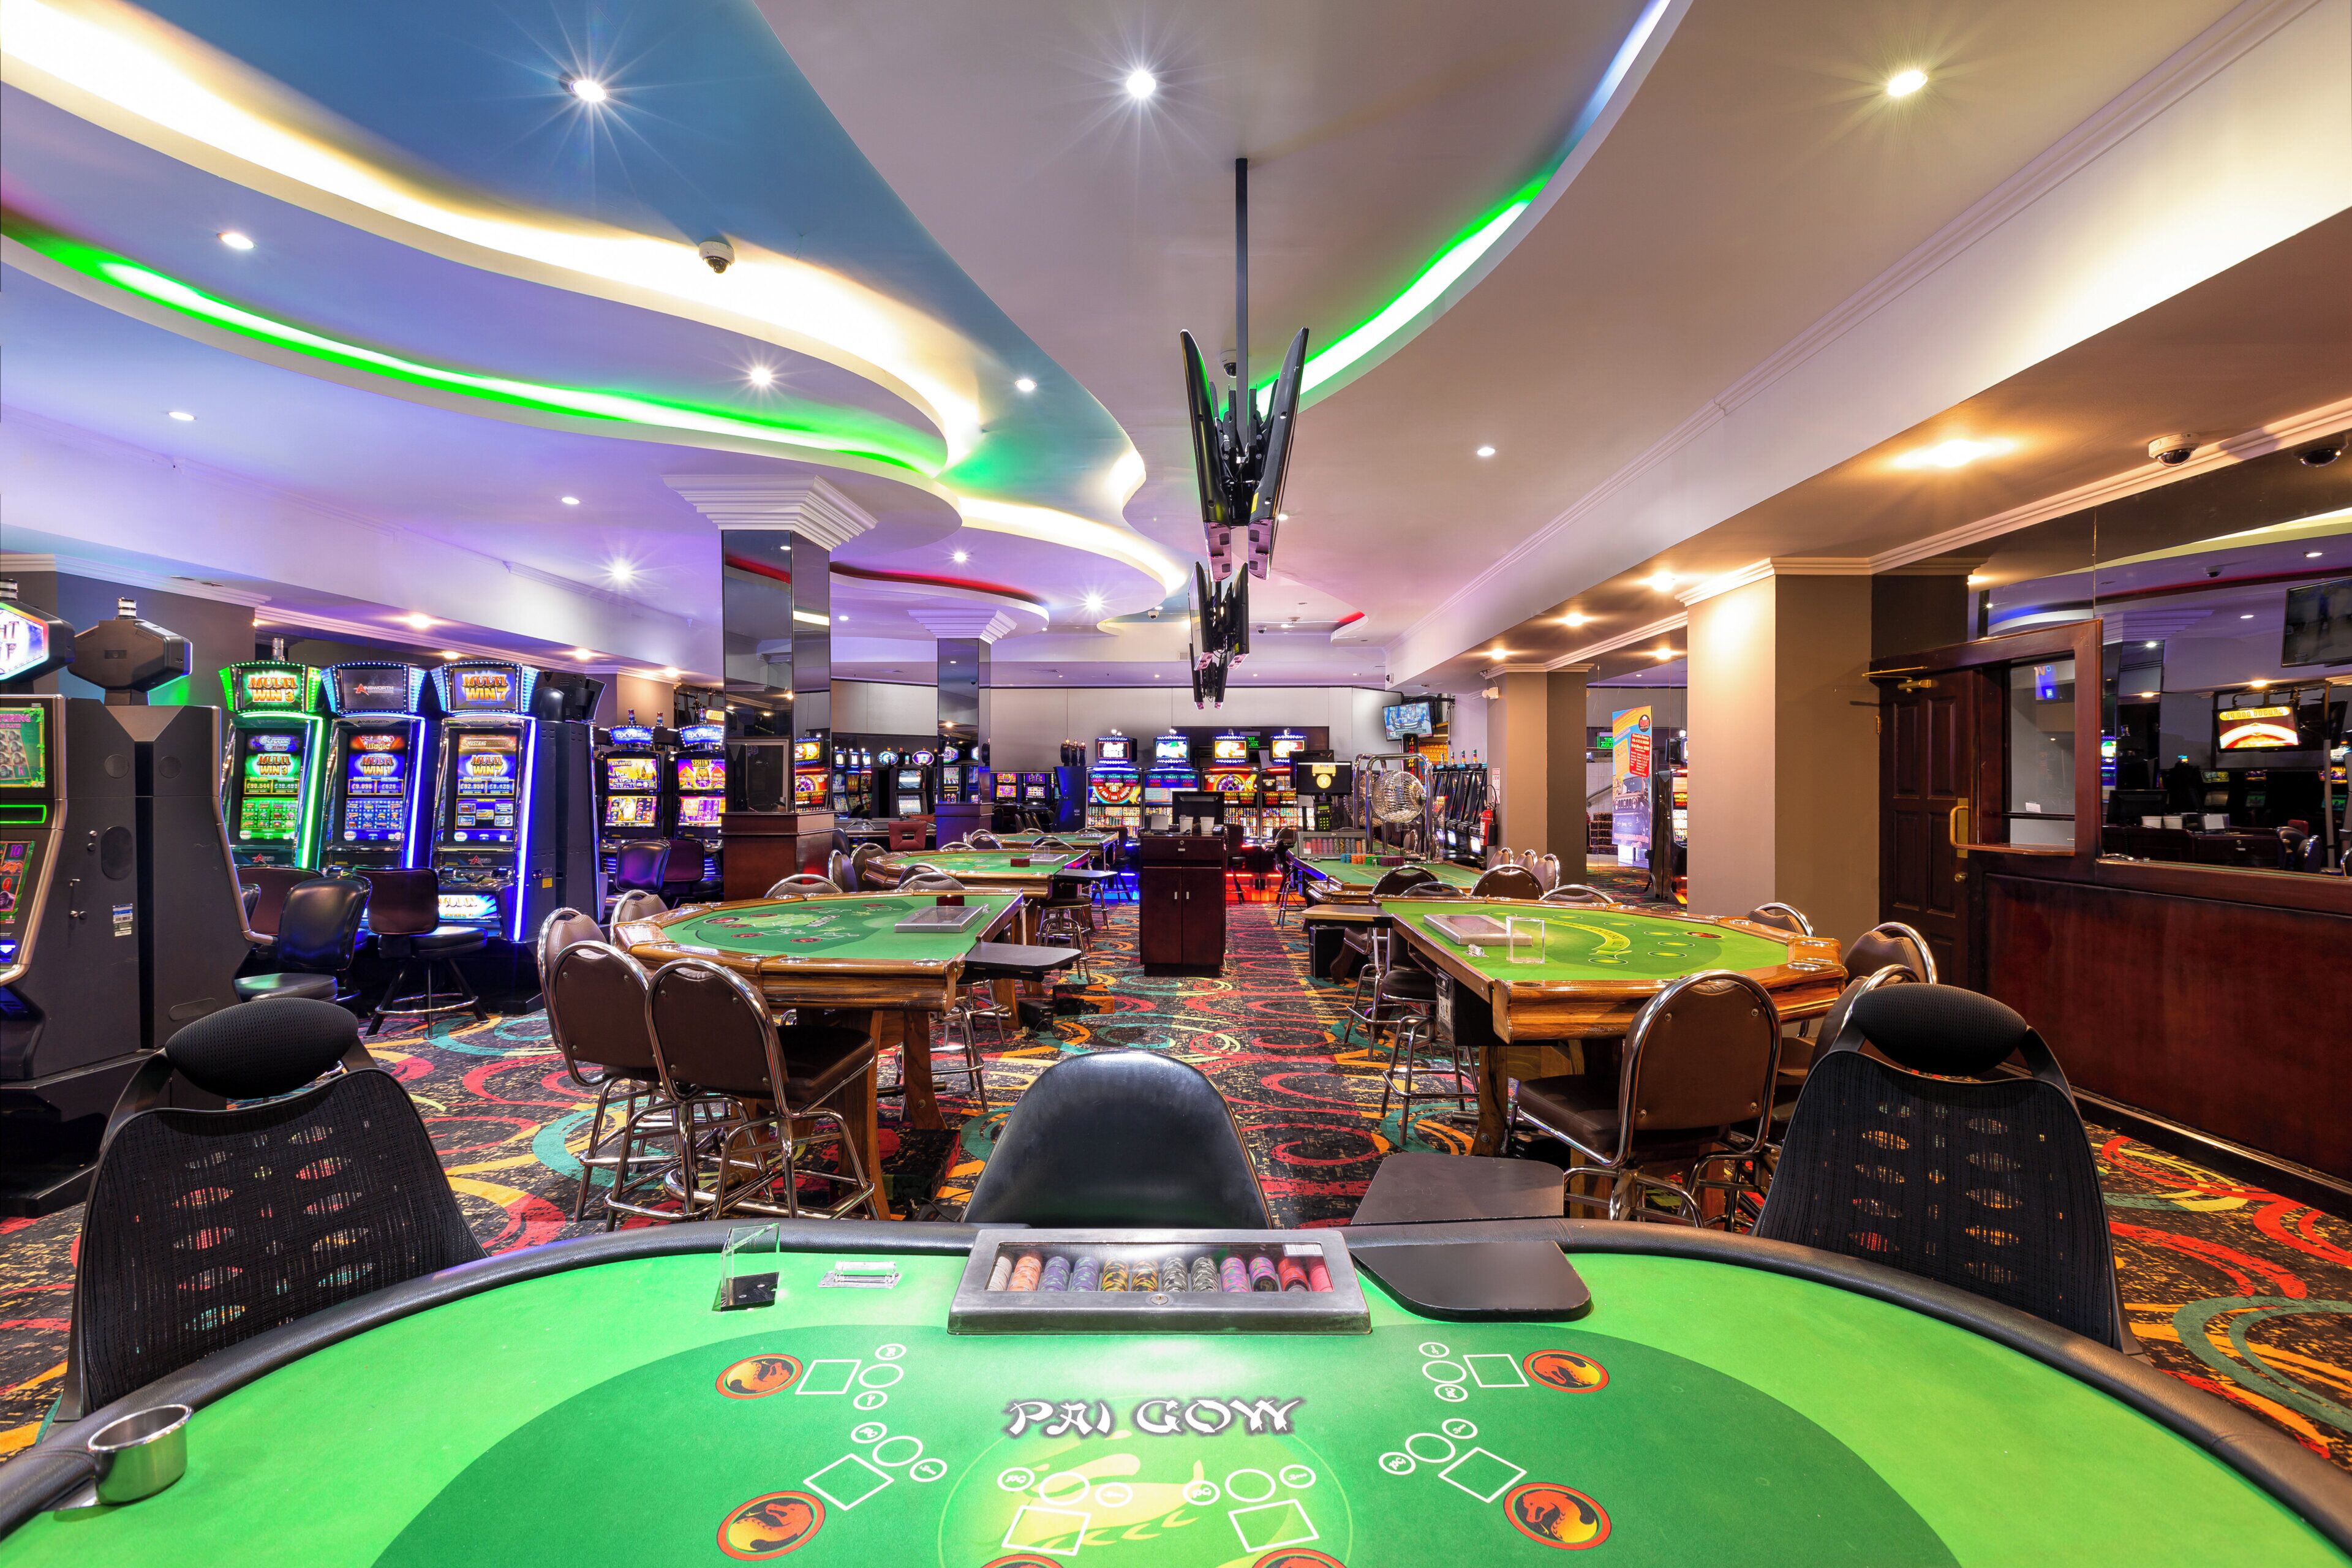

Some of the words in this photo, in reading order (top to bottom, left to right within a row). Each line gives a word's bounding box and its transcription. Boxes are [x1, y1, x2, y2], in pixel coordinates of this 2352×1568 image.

[247, 677, 298, 689] MULTI
[462, 675, 508, 687] MULTI
[353, 684, 394, 696] AINSWORTH
[465, 687, 496, 701] WIN
[497, 687, 510, 701] 7
[252, 689, 282, 702] WIN
[285, 689, 295, 703] 3
[257, 756, 290, 765] MULTI
[360, 756, 393, 766] MULTI
[472, 756, 503, 765] MULTI
[260, 766, 280, 775] WIN
[282, 765, 288, 775] 3
[363, 766, 383, 775] WIN
[385, 766, 391, 775] 1
[473, 766, 494, 775] WIN
[495, 766, 503, 775] 7
[10, 845, 23, 856] 10
[1008, 1399, 1112, 1436] PAI
[1135, 1398, 1301, 1434] GOW
[1389, 1457, 1406, 1470] PG
[1191, 1487, 1213, 1498] PG
